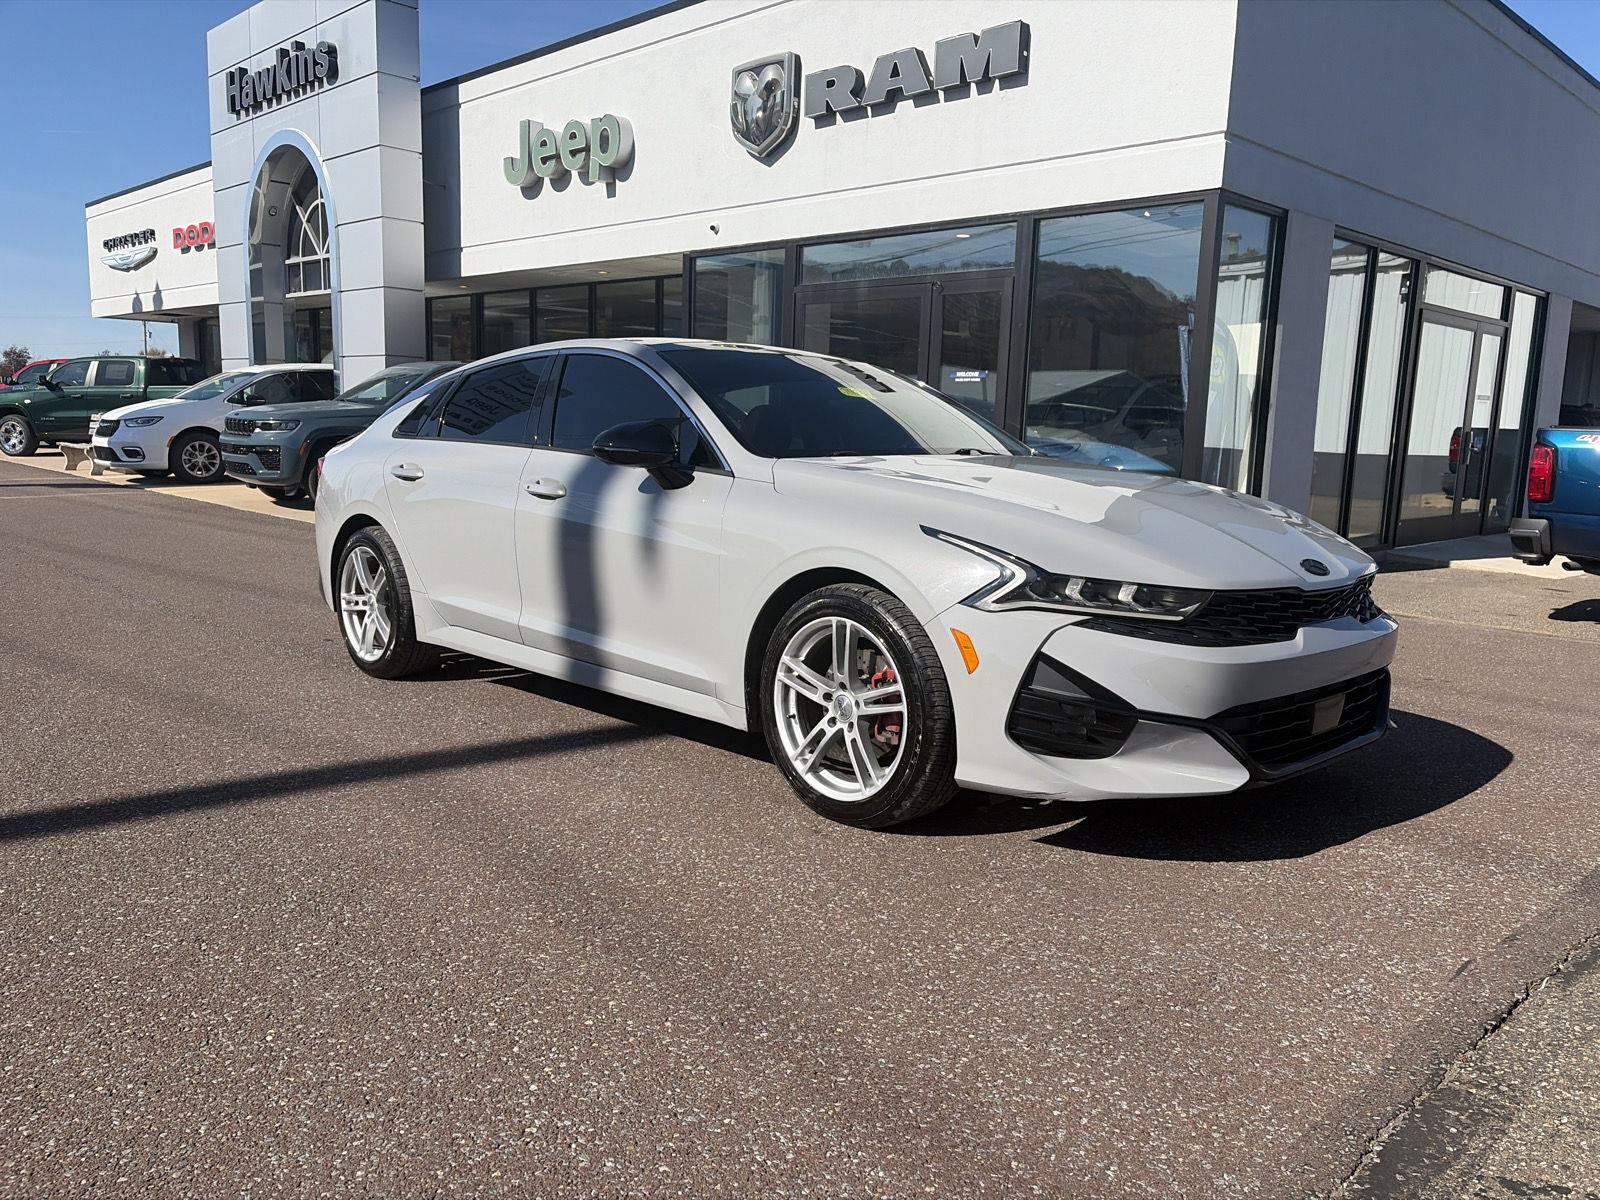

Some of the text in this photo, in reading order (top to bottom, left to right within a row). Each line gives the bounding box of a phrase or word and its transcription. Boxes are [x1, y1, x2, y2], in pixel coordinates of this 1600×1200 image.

[226, 40, 337, 115] Hawkins
[805, 20, 1030, 120] RAM
[503, 113, 629, 188] Jeep
[103, 228, 155, 249] CHRYSLER
[173, 221, 216, 249] DOD
